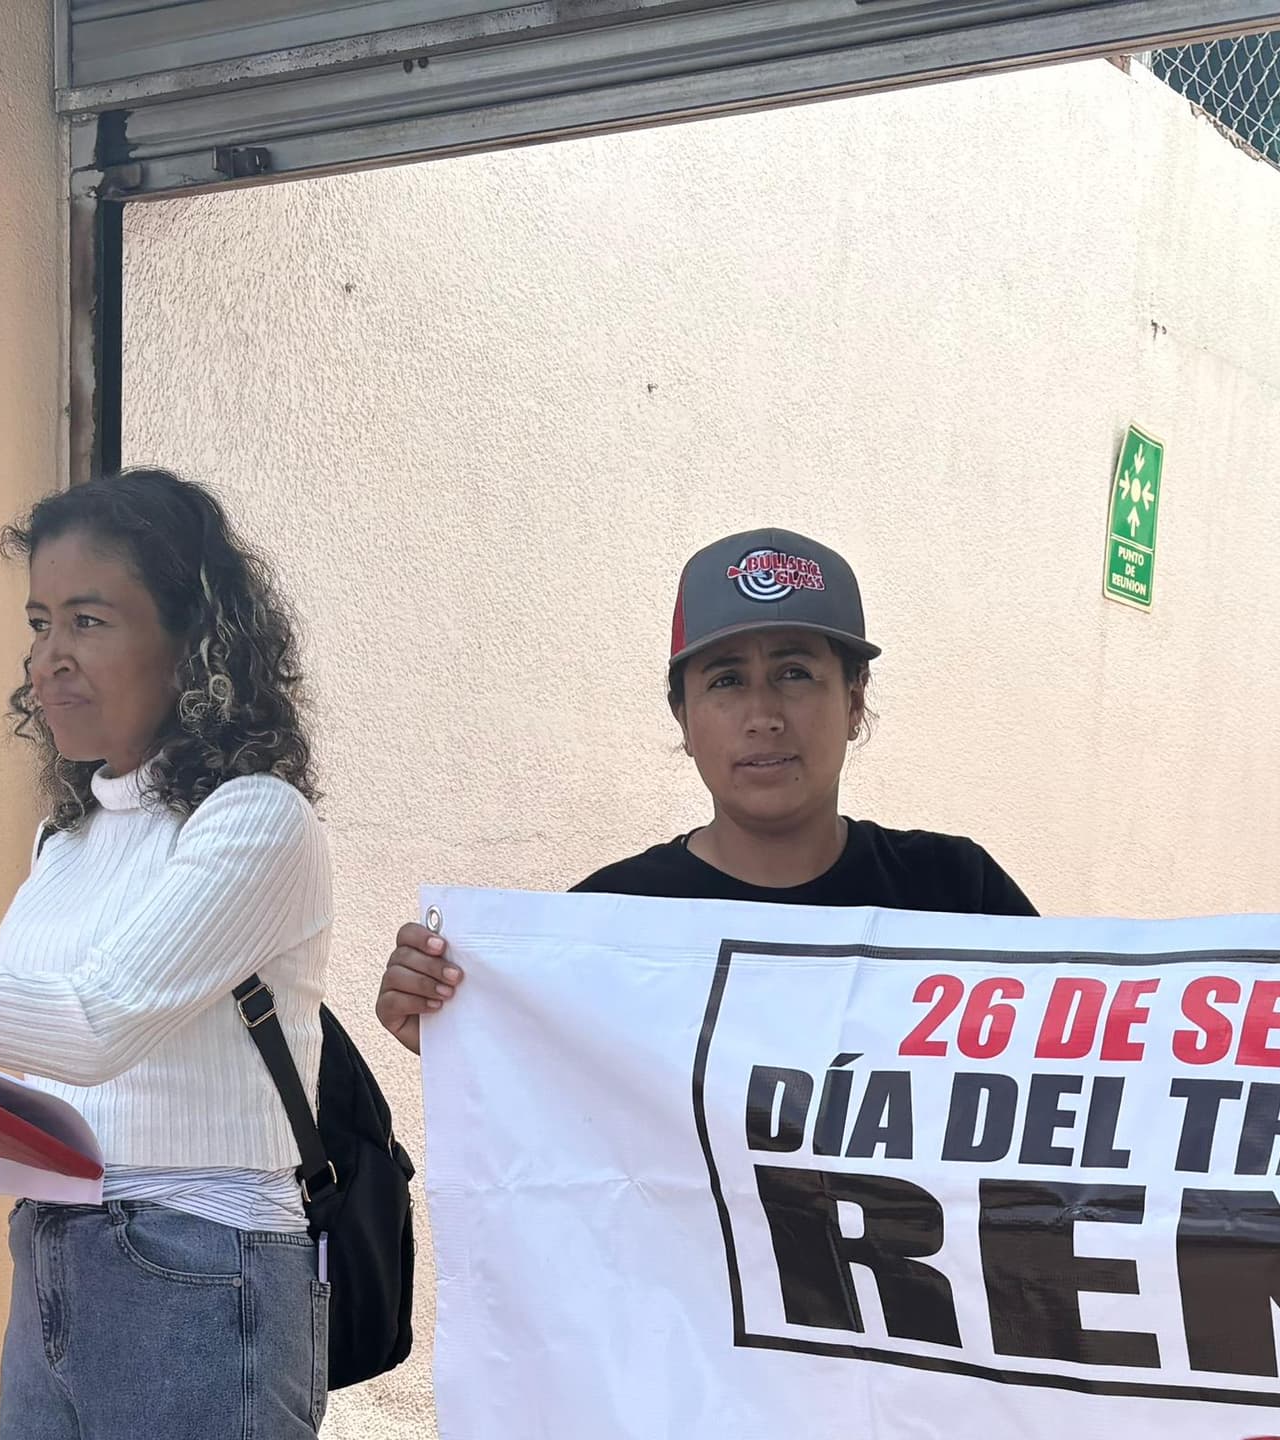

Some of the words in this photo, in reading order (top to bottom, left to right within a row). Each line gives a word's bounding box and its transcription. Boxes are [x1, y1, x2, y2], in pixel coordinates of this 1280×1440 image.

[1118, 545, 1145, 567] PUNTO
[773, 569, 825, 591] GLASS
[1125, 562, 1136, 578] DE
[1112, 572, 1147, 597] REUNION
[898, 974, 1025, 1060] 26
[1034, 976, 1160, 1063] DE
[745, 1052, 915, 1160] DÍA
[939, 1072, 1132, 1170] DEL
